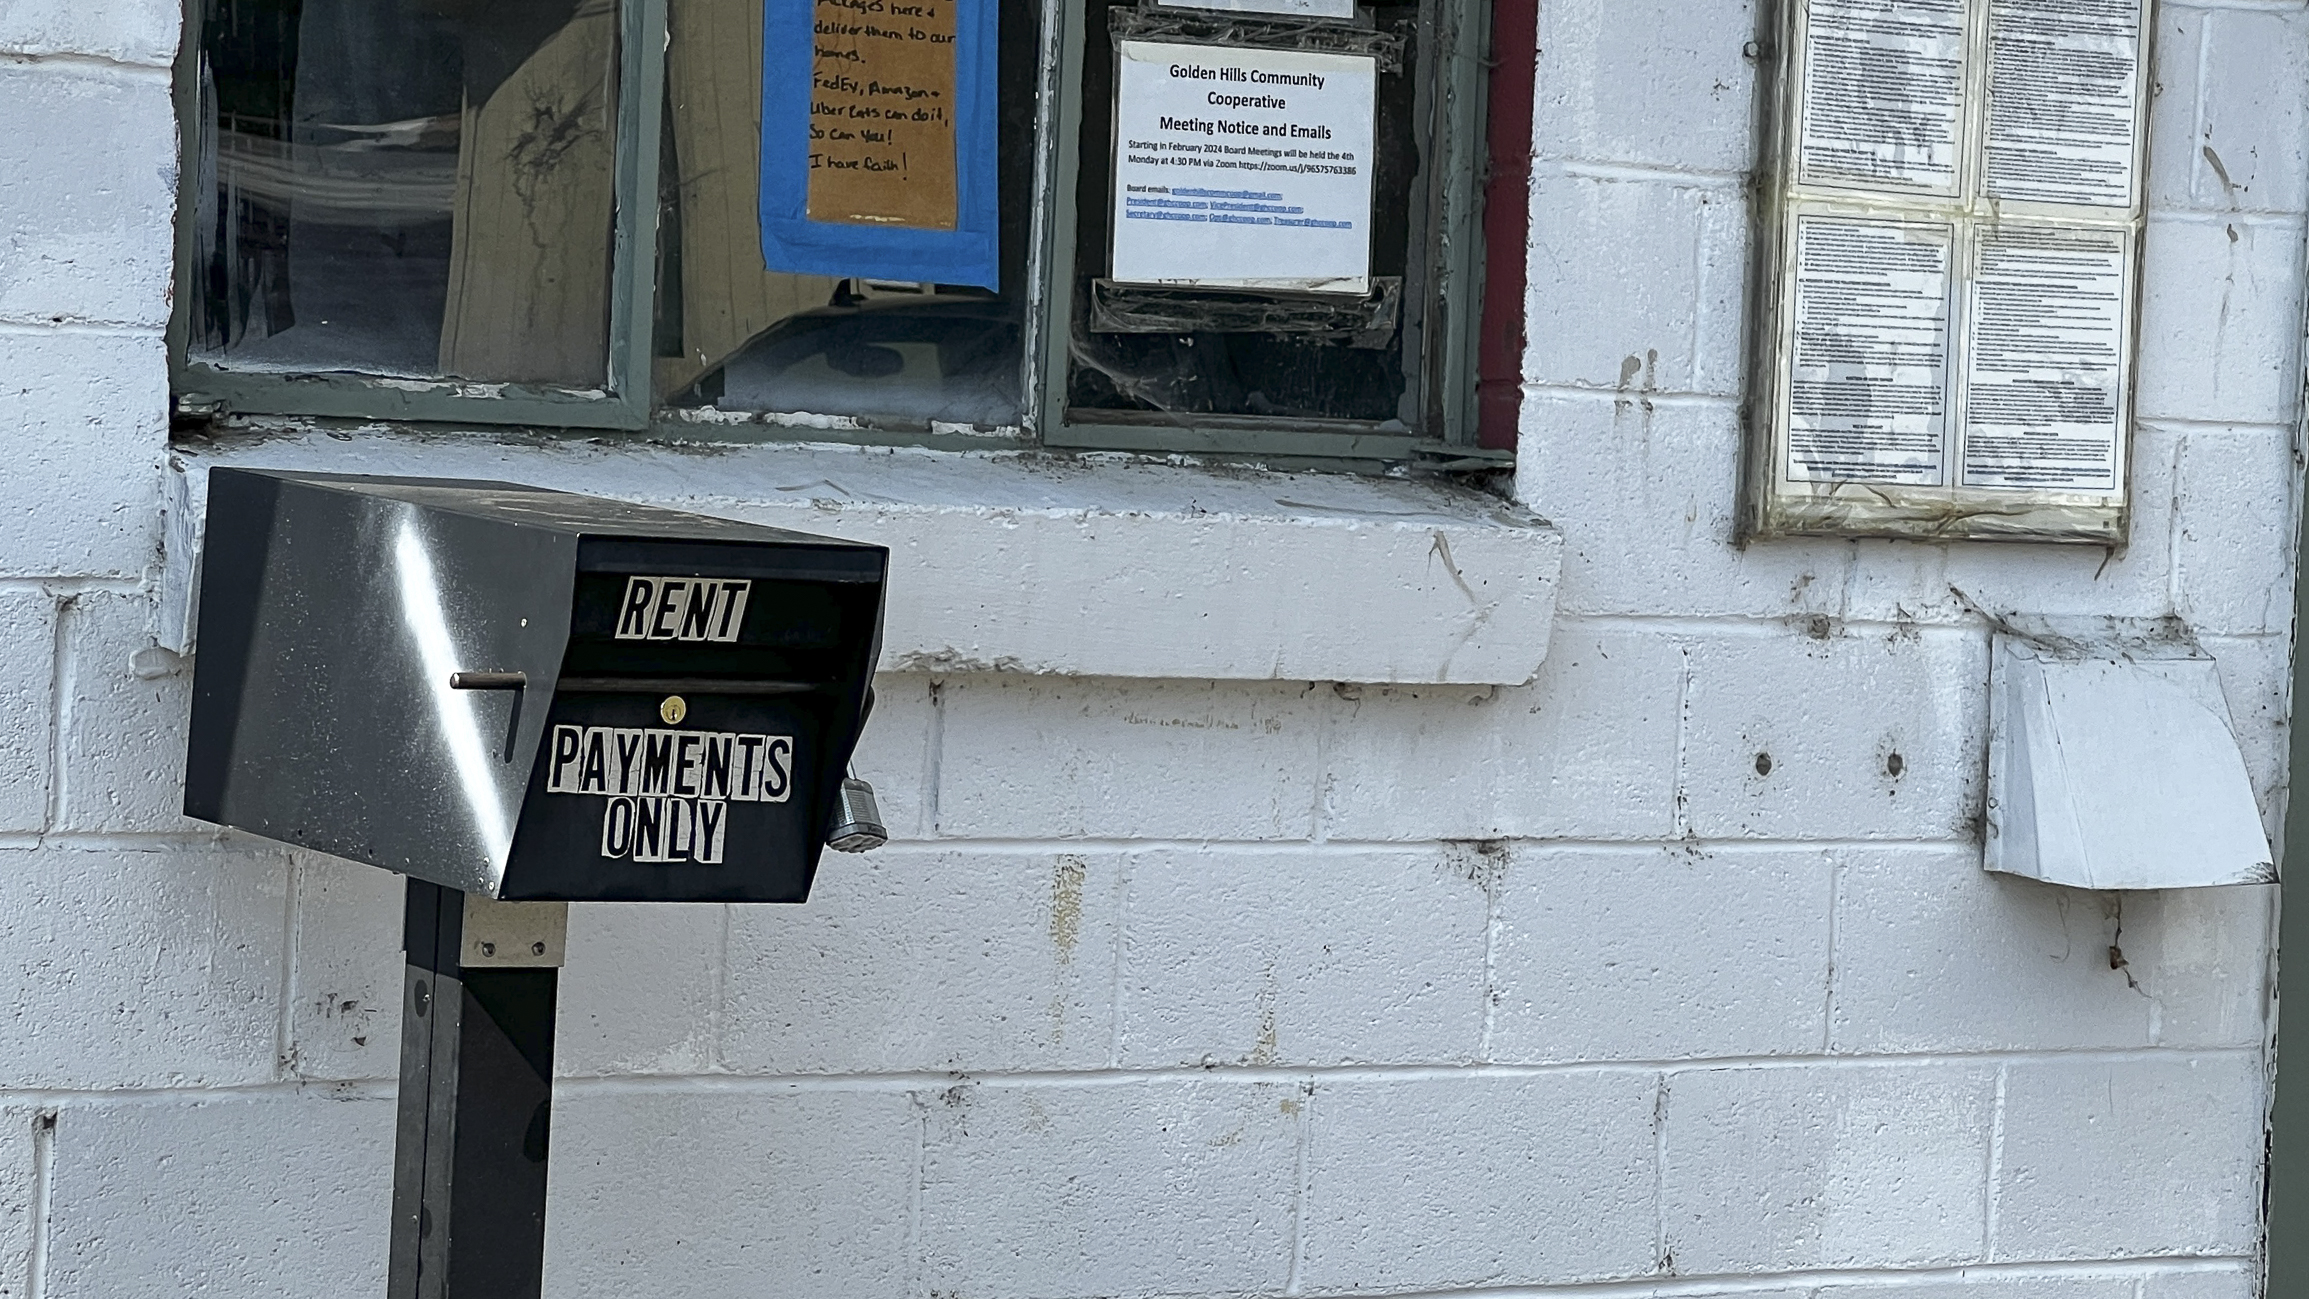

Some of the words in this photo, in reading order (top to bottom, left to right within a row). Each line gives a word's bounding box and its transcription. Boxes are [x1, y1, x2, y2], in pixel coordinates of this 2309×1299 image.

[891, 3, 922, 17] here
[814, 20, 862, 35] deliver
[864, 25, 903, 40] them
[908, 27, 926, 40] to
[930, 33, 956, 43] our
[1169, 64, 1216, 80] Golden
[1220, 67, 1247, 82] Hills
[1250, 69, 1325, 90] Community
[1207, 91, 1286, 109] Cooperative
[810, 101, 846, 115] Uber
[849, 105, 880, 119] Eats
[885, 109, 908, 120] can
[911, 107, 928, 121] do
[809, 124, 825, 139] So
[1159, 116, 1214, 135] Meeting
[1217, 120, 1259, 135] Notice
[1262, 123, 1287, 137] and
[1290, 124, 1332, 139] Emails
[1128, 140, 1158, 151] Starting
[1168, 142, 1202, 153] February
[1203, 144, 1222, 153] 2024
[1224, 145, 1246, 155] Board
[1247, 147, 1282, 158] Meetings
[1284, 149, 1297, 157] will
[1298, 150, 1308, 158] be
[1309, 151, 1326, 159] held
[1327, 151, 1340, 160] the
[1341, 152, 1355, 160] 4th
[808, 153, 823, 169] I
[827, 156, 859, 170] have
[1128, 155, 1159, 166] Monday
[1160, 157, 1169, 165] at
[1170, 157, 1187, 166] 4:30
[1188, 158, 1202, 166] PM
[1203, 159, 1214, 167] via
[1215, 160, 1237, 168] Zoom
[1126, 184, 1146, 193] Board
[619, 579, 748, 638] RENT
[551, 727, 791, 798] PAYMENTS
[606, 797, 725, 862] ONLY
